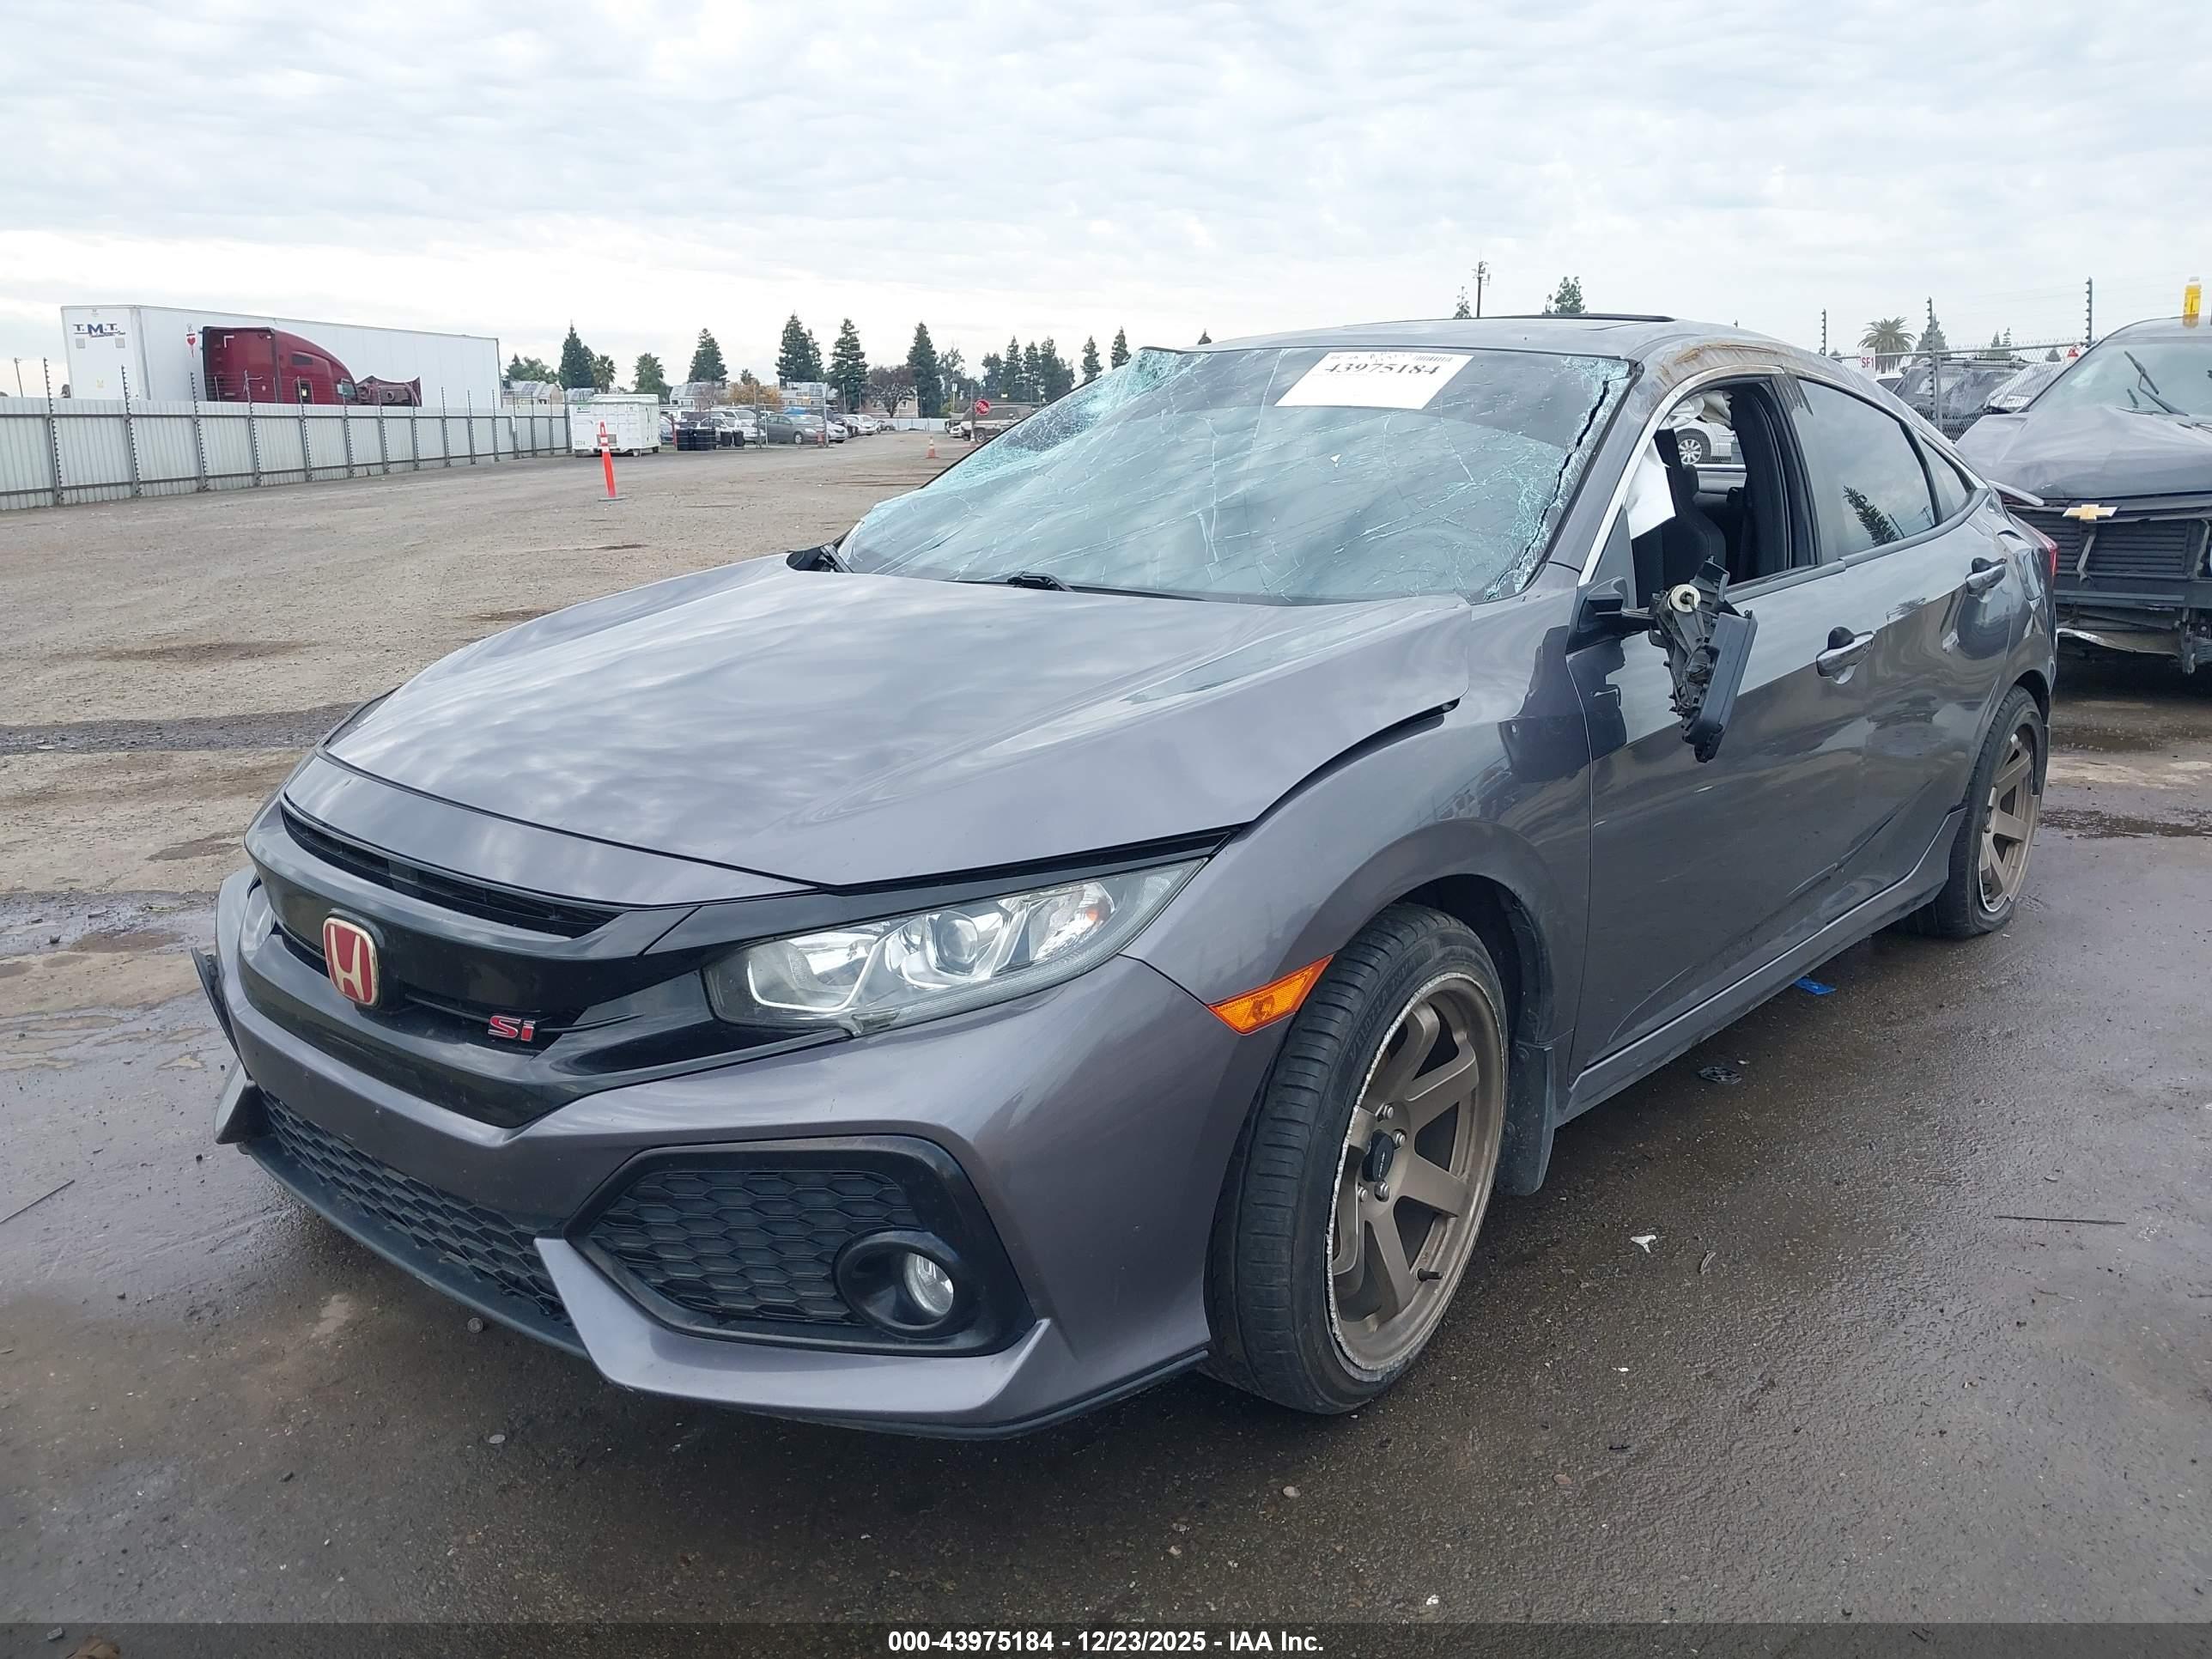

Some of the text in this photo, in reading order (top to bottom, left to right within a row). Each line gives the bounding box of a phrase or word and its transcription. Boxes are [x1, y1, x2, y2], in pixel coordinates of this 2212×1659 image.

[1325, 362, 1441, 375] 43975184
[1861, 356, 1875, 368] SF1
[487, 1015, 537, 1042] Si
